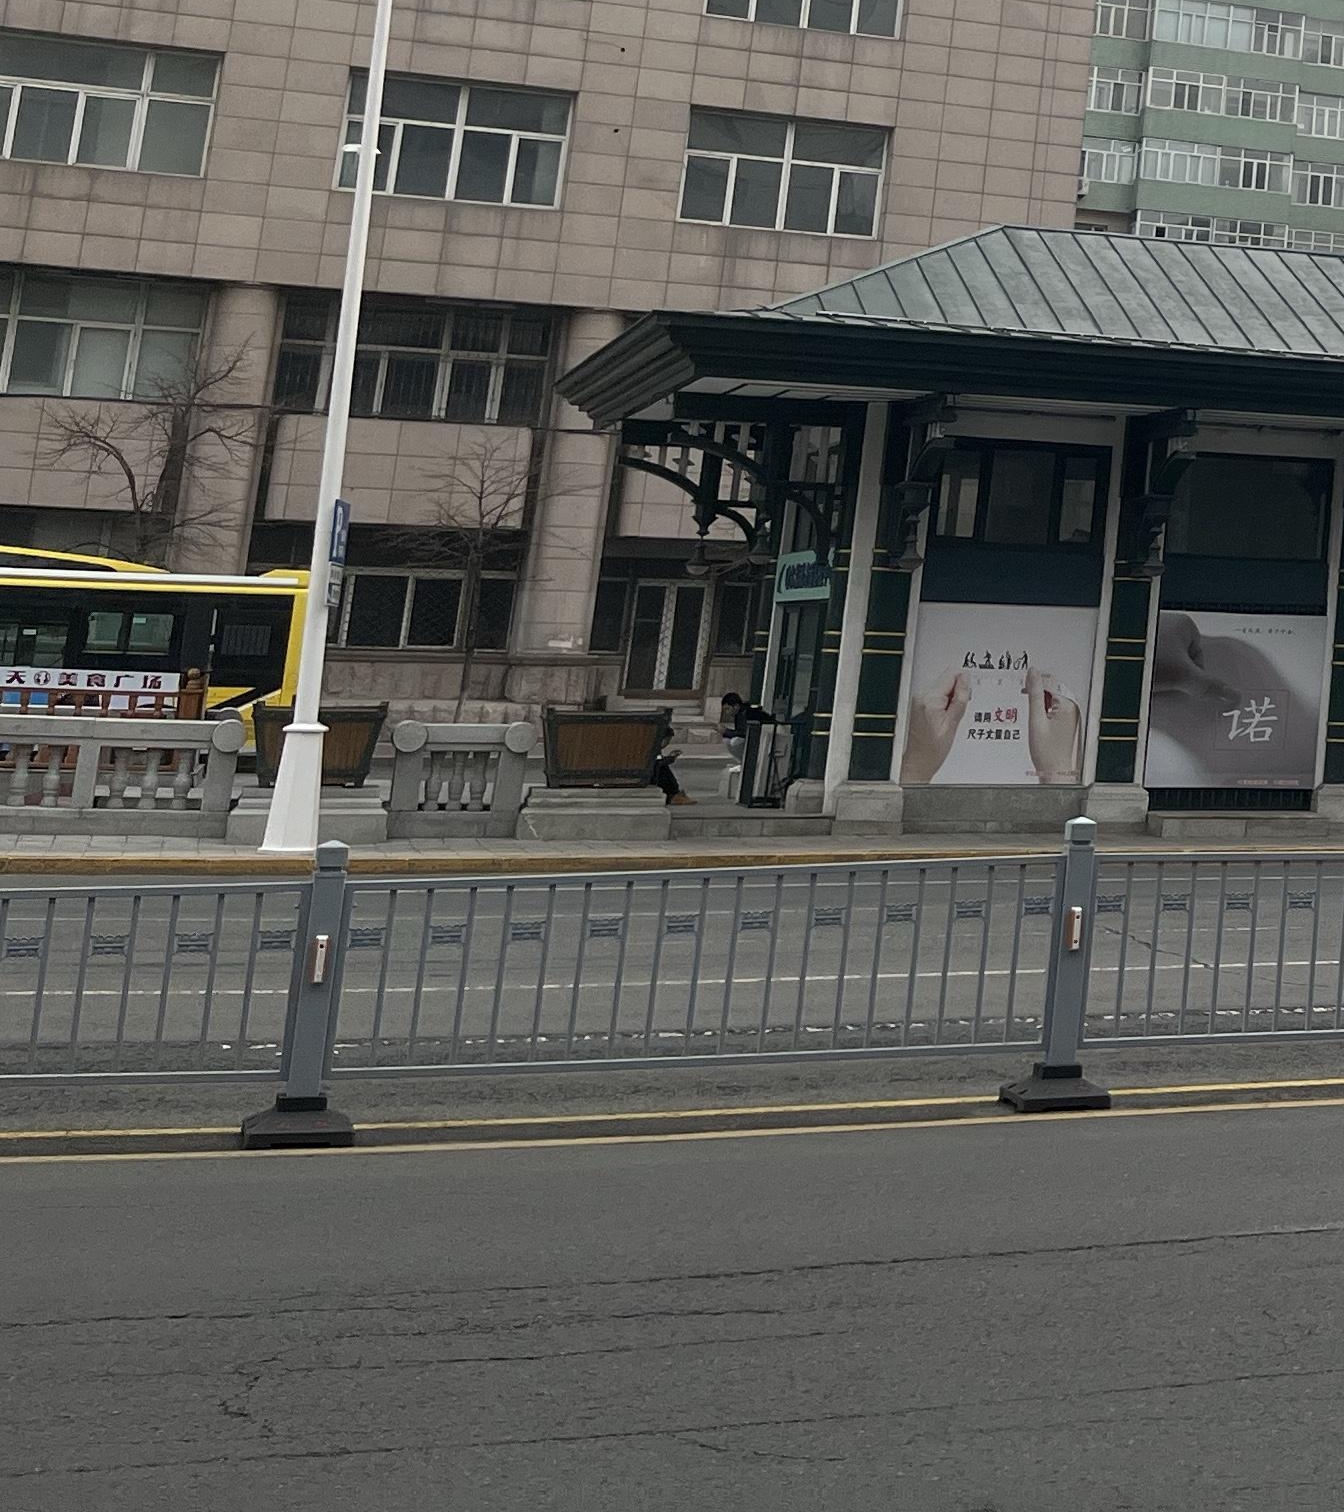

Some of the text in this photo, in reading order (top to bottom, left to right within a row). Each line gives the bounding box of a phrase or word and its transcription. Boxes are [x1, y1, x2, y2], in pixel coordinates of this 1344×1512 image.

[57, 672, 162, 690] 美食广场
[1222, 696, 1279, 743] 诺
